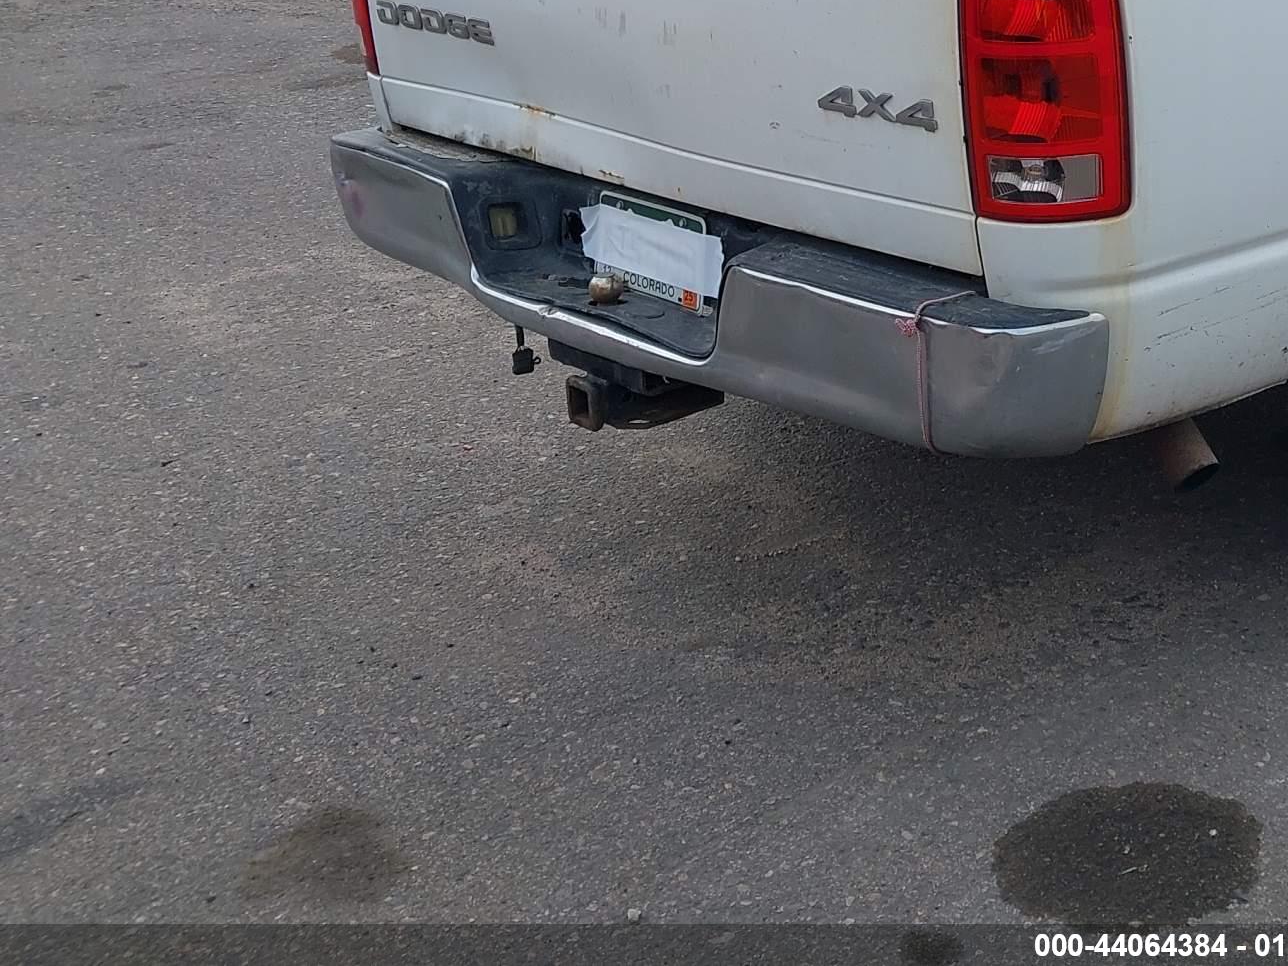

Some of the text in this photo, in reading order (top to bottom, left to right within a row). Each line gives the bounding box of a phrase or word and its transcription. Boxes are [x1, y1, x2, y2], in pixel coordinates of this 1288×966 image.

[376, 0, 495, 46] DODGE
[817, 85, 939, 133] 4X4
[622, 271, 675, 297] COLORADO
